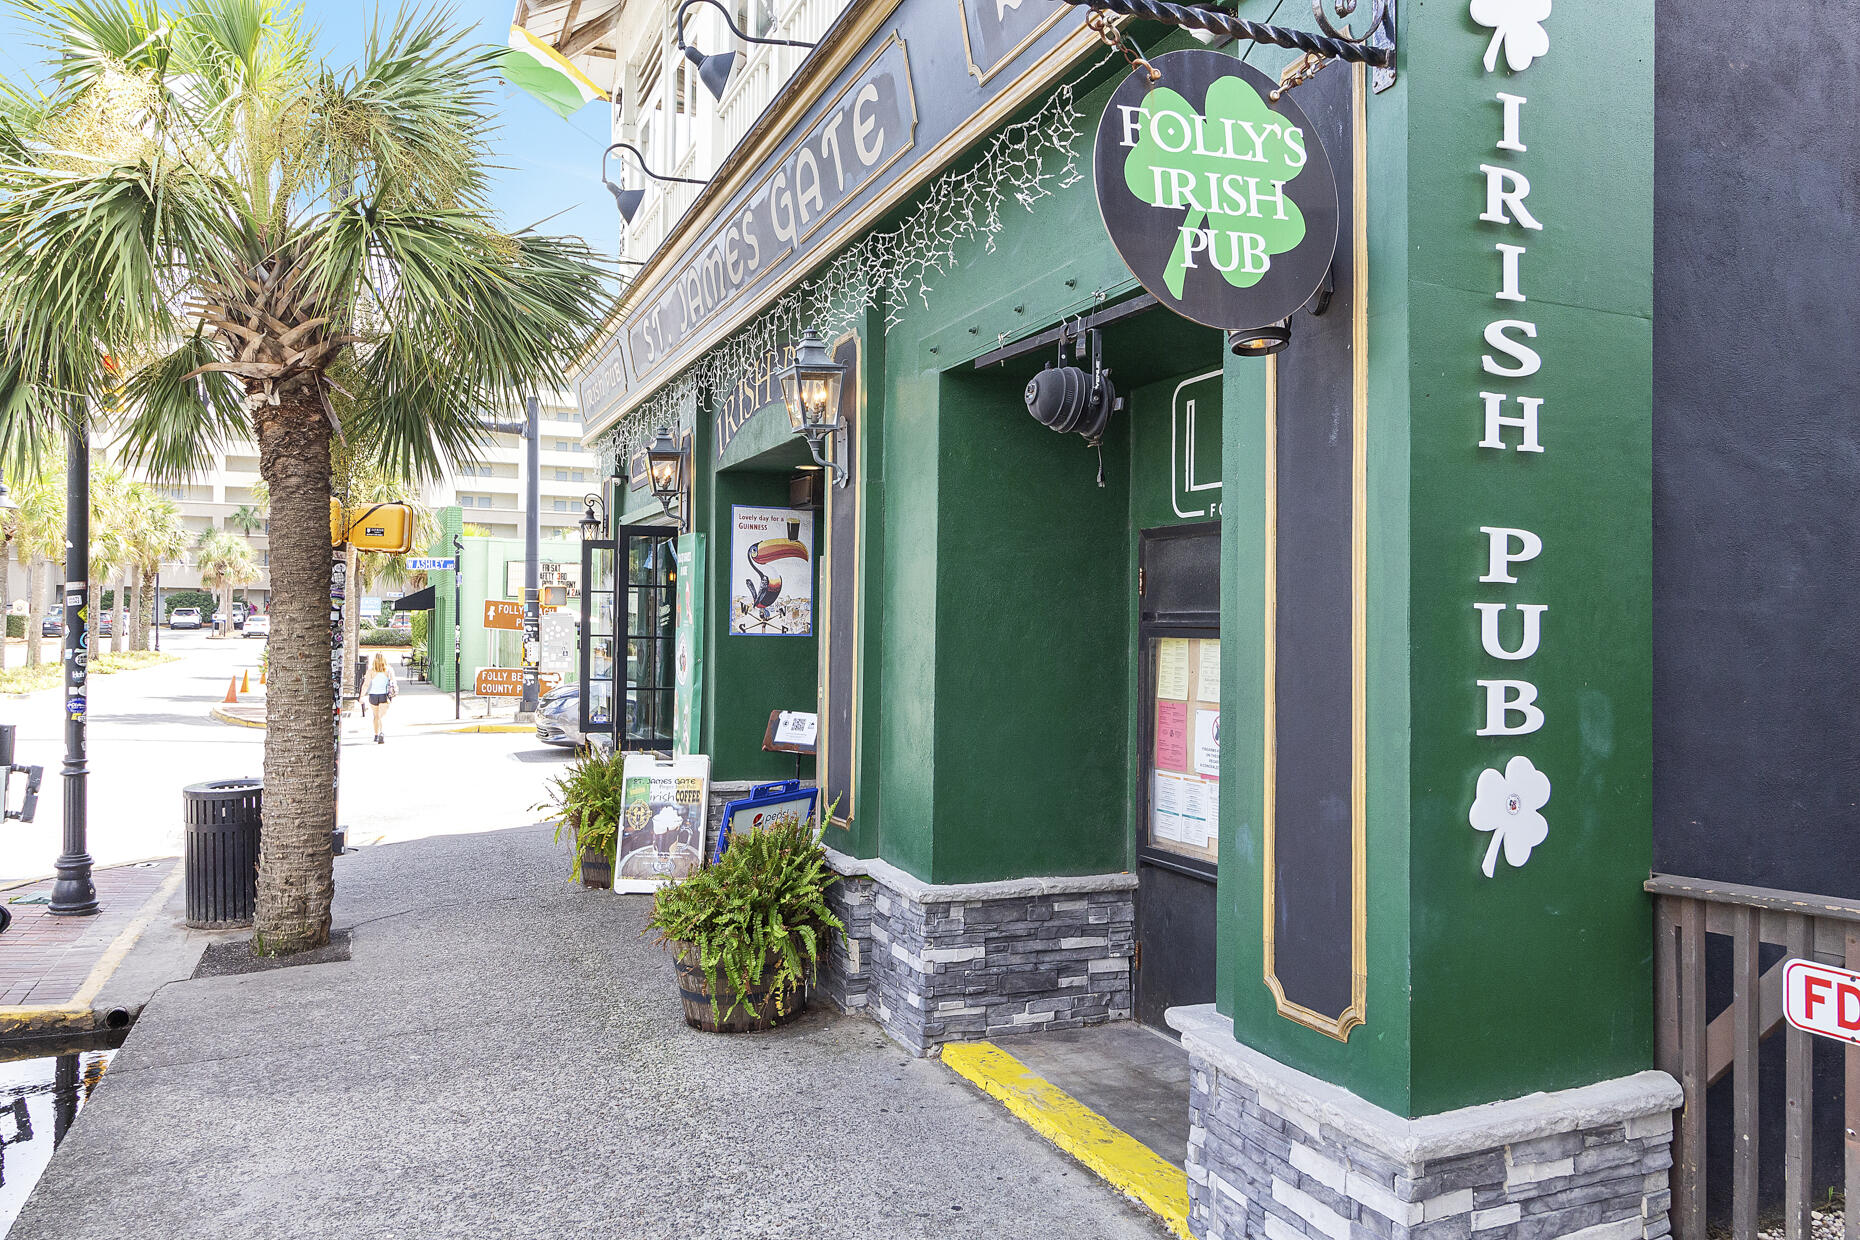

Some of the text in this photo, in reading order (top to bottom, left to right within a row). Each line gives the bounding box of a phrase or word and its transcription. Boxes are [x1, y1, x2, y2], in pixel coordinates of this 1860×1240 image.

[1116, 104, 1308, 168] FOLLY'S
[1148, 165, 1289, 221] IRISH
[642, 83, 885, 362] ST. JAMES GATE
[1178, 226, 1271, 274] PUB
[716, 350, 772, 461] IRISH
[1473, 92, 1549, 737] IRISH PUB
[738, 513, 757, 522] Lovely
[738, 522, 768, 531] GUINNESS
[416, 559, 444, 570] ASHLEY
[498, 604, 524, 615] FOLLY
[482, 671, 523, 682] FOLLY BE
[481, 683, 513, 694] COUNTY
[675, 789, 701, 803] COFFEE
